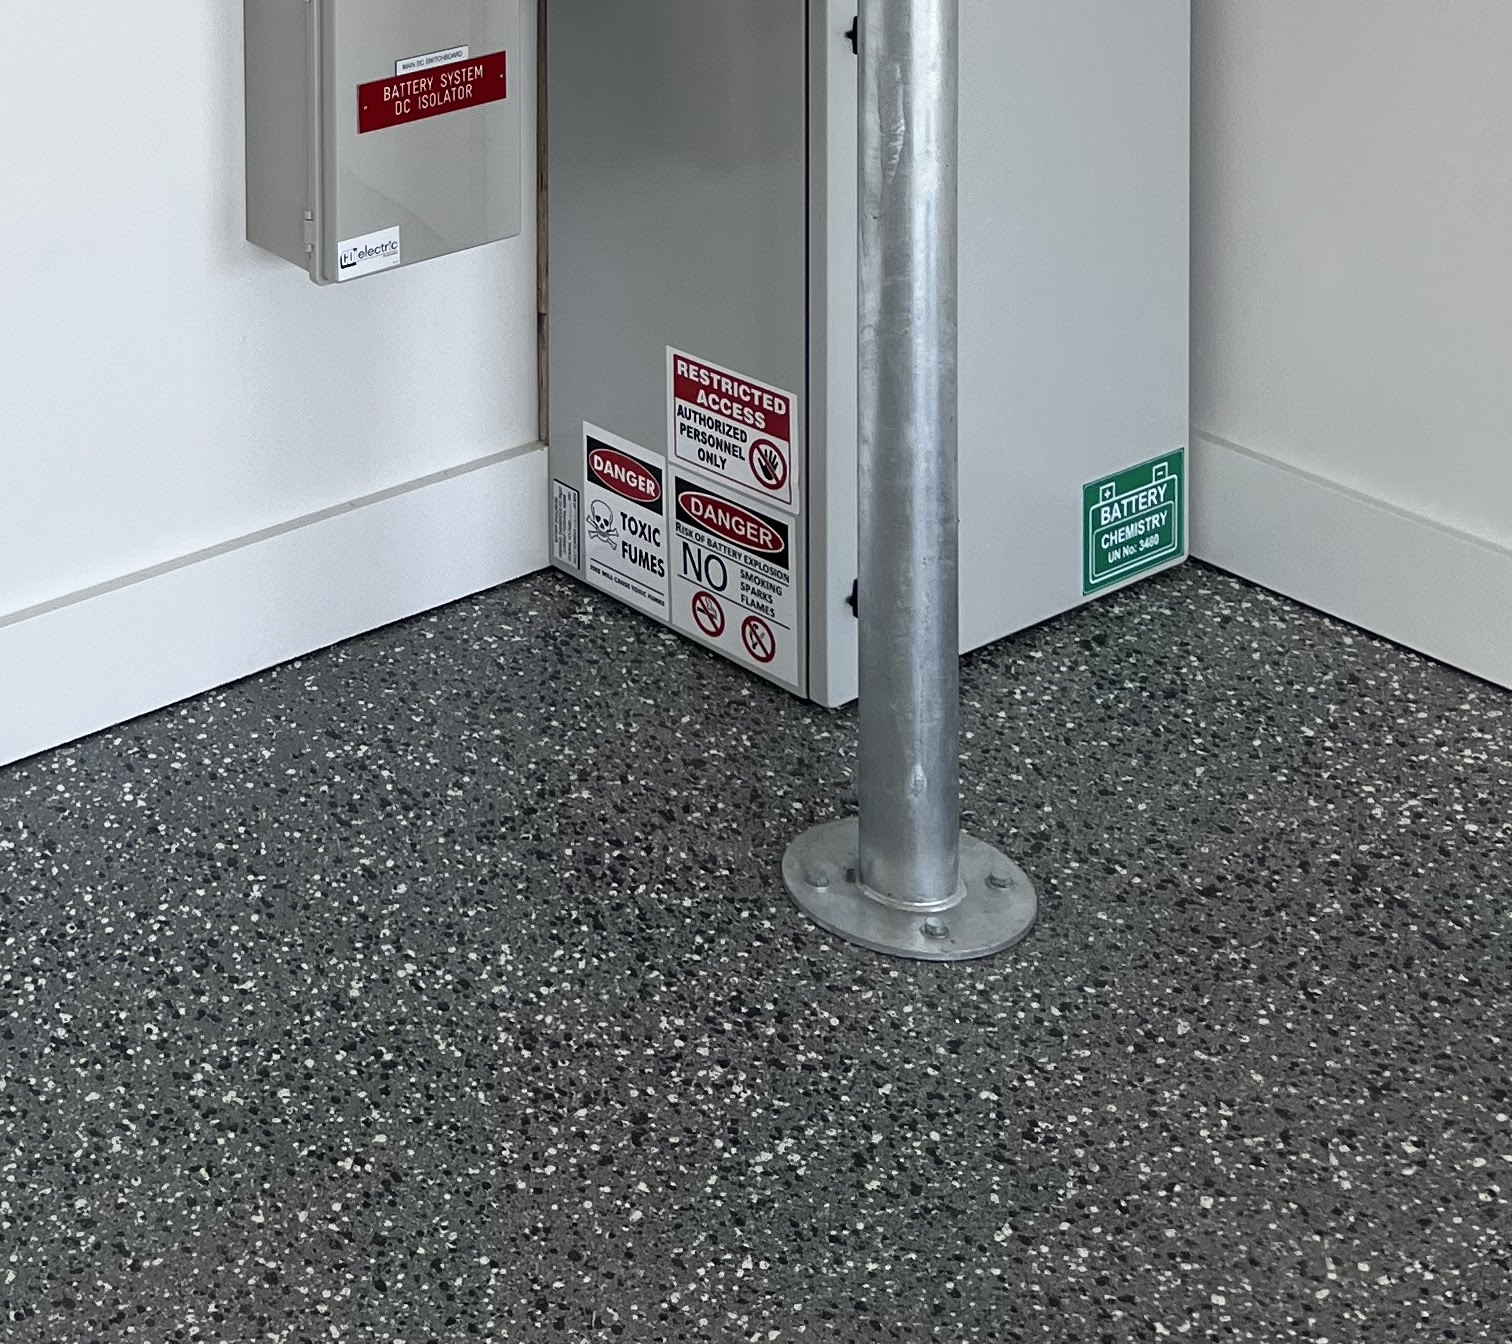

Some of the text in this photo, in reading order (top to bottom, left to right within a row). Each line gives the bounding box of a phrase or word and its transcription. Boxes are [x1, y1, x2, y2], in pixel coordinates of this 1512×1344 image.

[402, 50, 463, 70] MAIN DC SWITCHBOARD
[383, 65, 483, 101] BATTERY SYSTEM
[395, 84, 473, 116] DC ISOLATOR
[358, 241, 398, 259] electric
[677, 359, 786, 415] RESTRICTED
[677, 404, 748, 443] AUTHORIZED
[697, 389, 765, 429] ACCESS
[680, 423, 745, 461] PERSONNEL
[698, 447, 727, 470] ONLY
[593, 455, 656, 497] DANGER
[691, 497, 773, 549] DANGER
[1100, 484, 1167, 526] BATTERY
[620, 511, 661, 547] TOXIC
[1101, 510, 1168, 549] CHEMISTRY
[622, 541, 665, 577] FUMES
[682, 542, 728, 591] NO
[695, 533, 705, 543] OF
[707, 538, 742, 560] BATTERY
[744, 555, 789, 583] EXPLOSION
[1108, 548, 1121, 563] UN
[1139, 534, 1159, 552] 3480
[602, 571, 613, 580] WILL
[614, 577, 630, 589] CAUSE
[631, 585, 646, 597] TOXIC
[648, 595, 665, 606] FUMES
[740, 569, 782, 596] SMOKING
[740, 582, 773, 604] SPARKS
[740, 594, 775, 617] FLAMES
